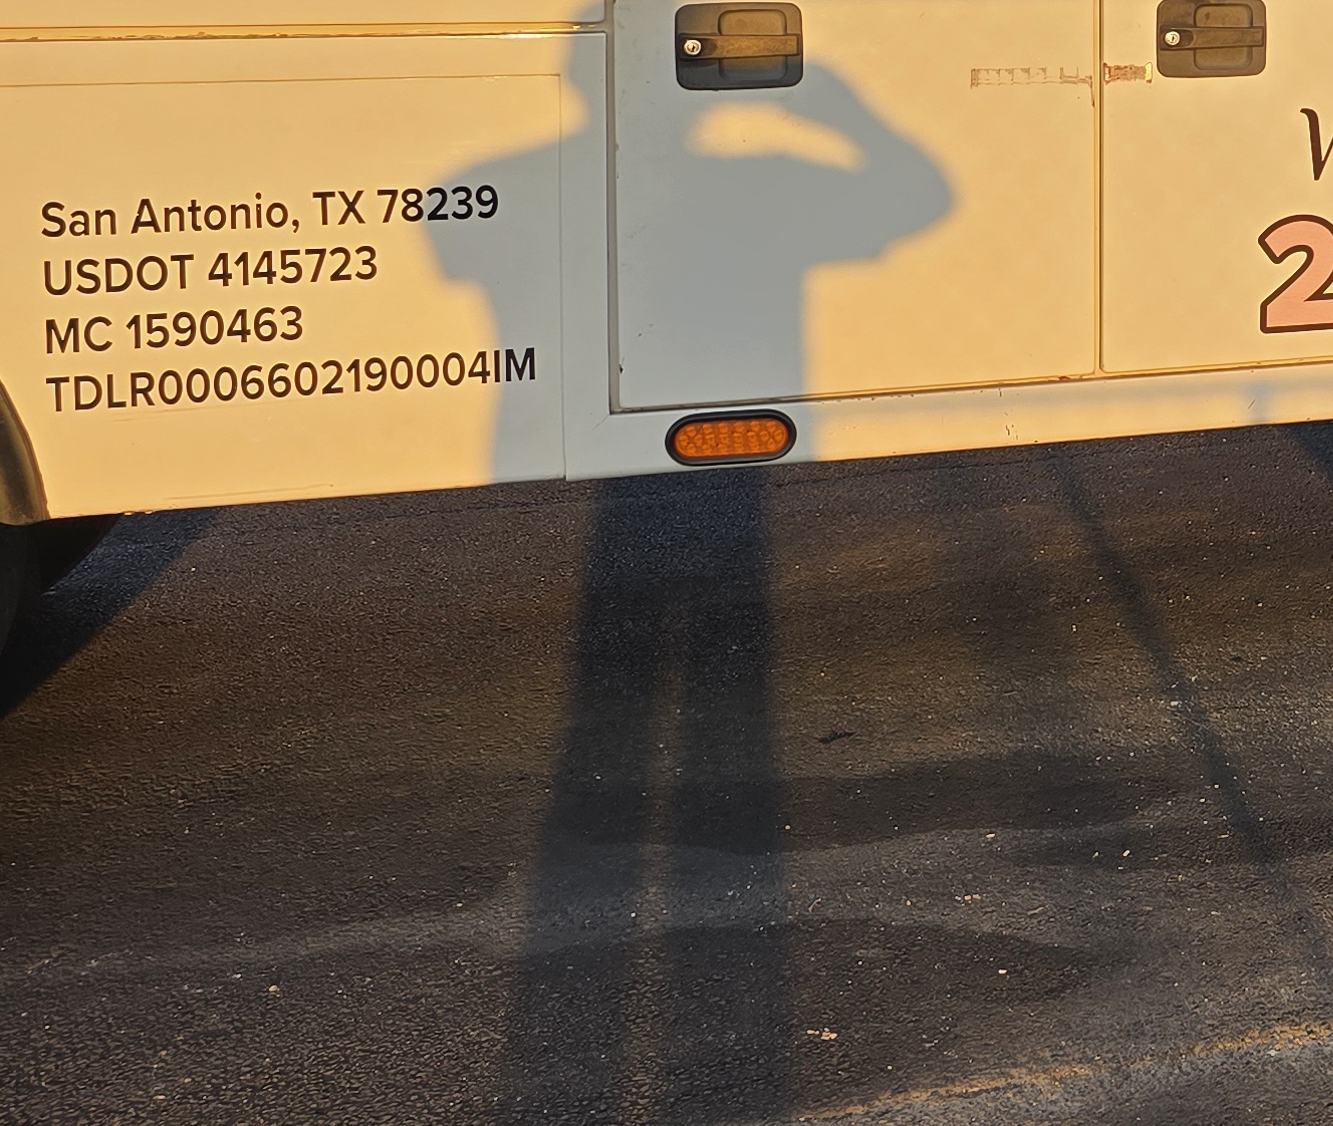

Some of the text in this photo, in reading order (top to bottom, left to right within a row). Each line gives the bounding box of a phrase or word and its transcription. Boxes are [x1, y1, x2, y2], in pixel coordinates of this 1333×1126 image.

[40, 184, 500, 239] San Antonio, TX 78239
[43, 245, 379, 296] USDOT 4145723
[44, 305, 304, 354] MC 1590463
[45, 347, 538, 412] TDLR0006602190004IM
